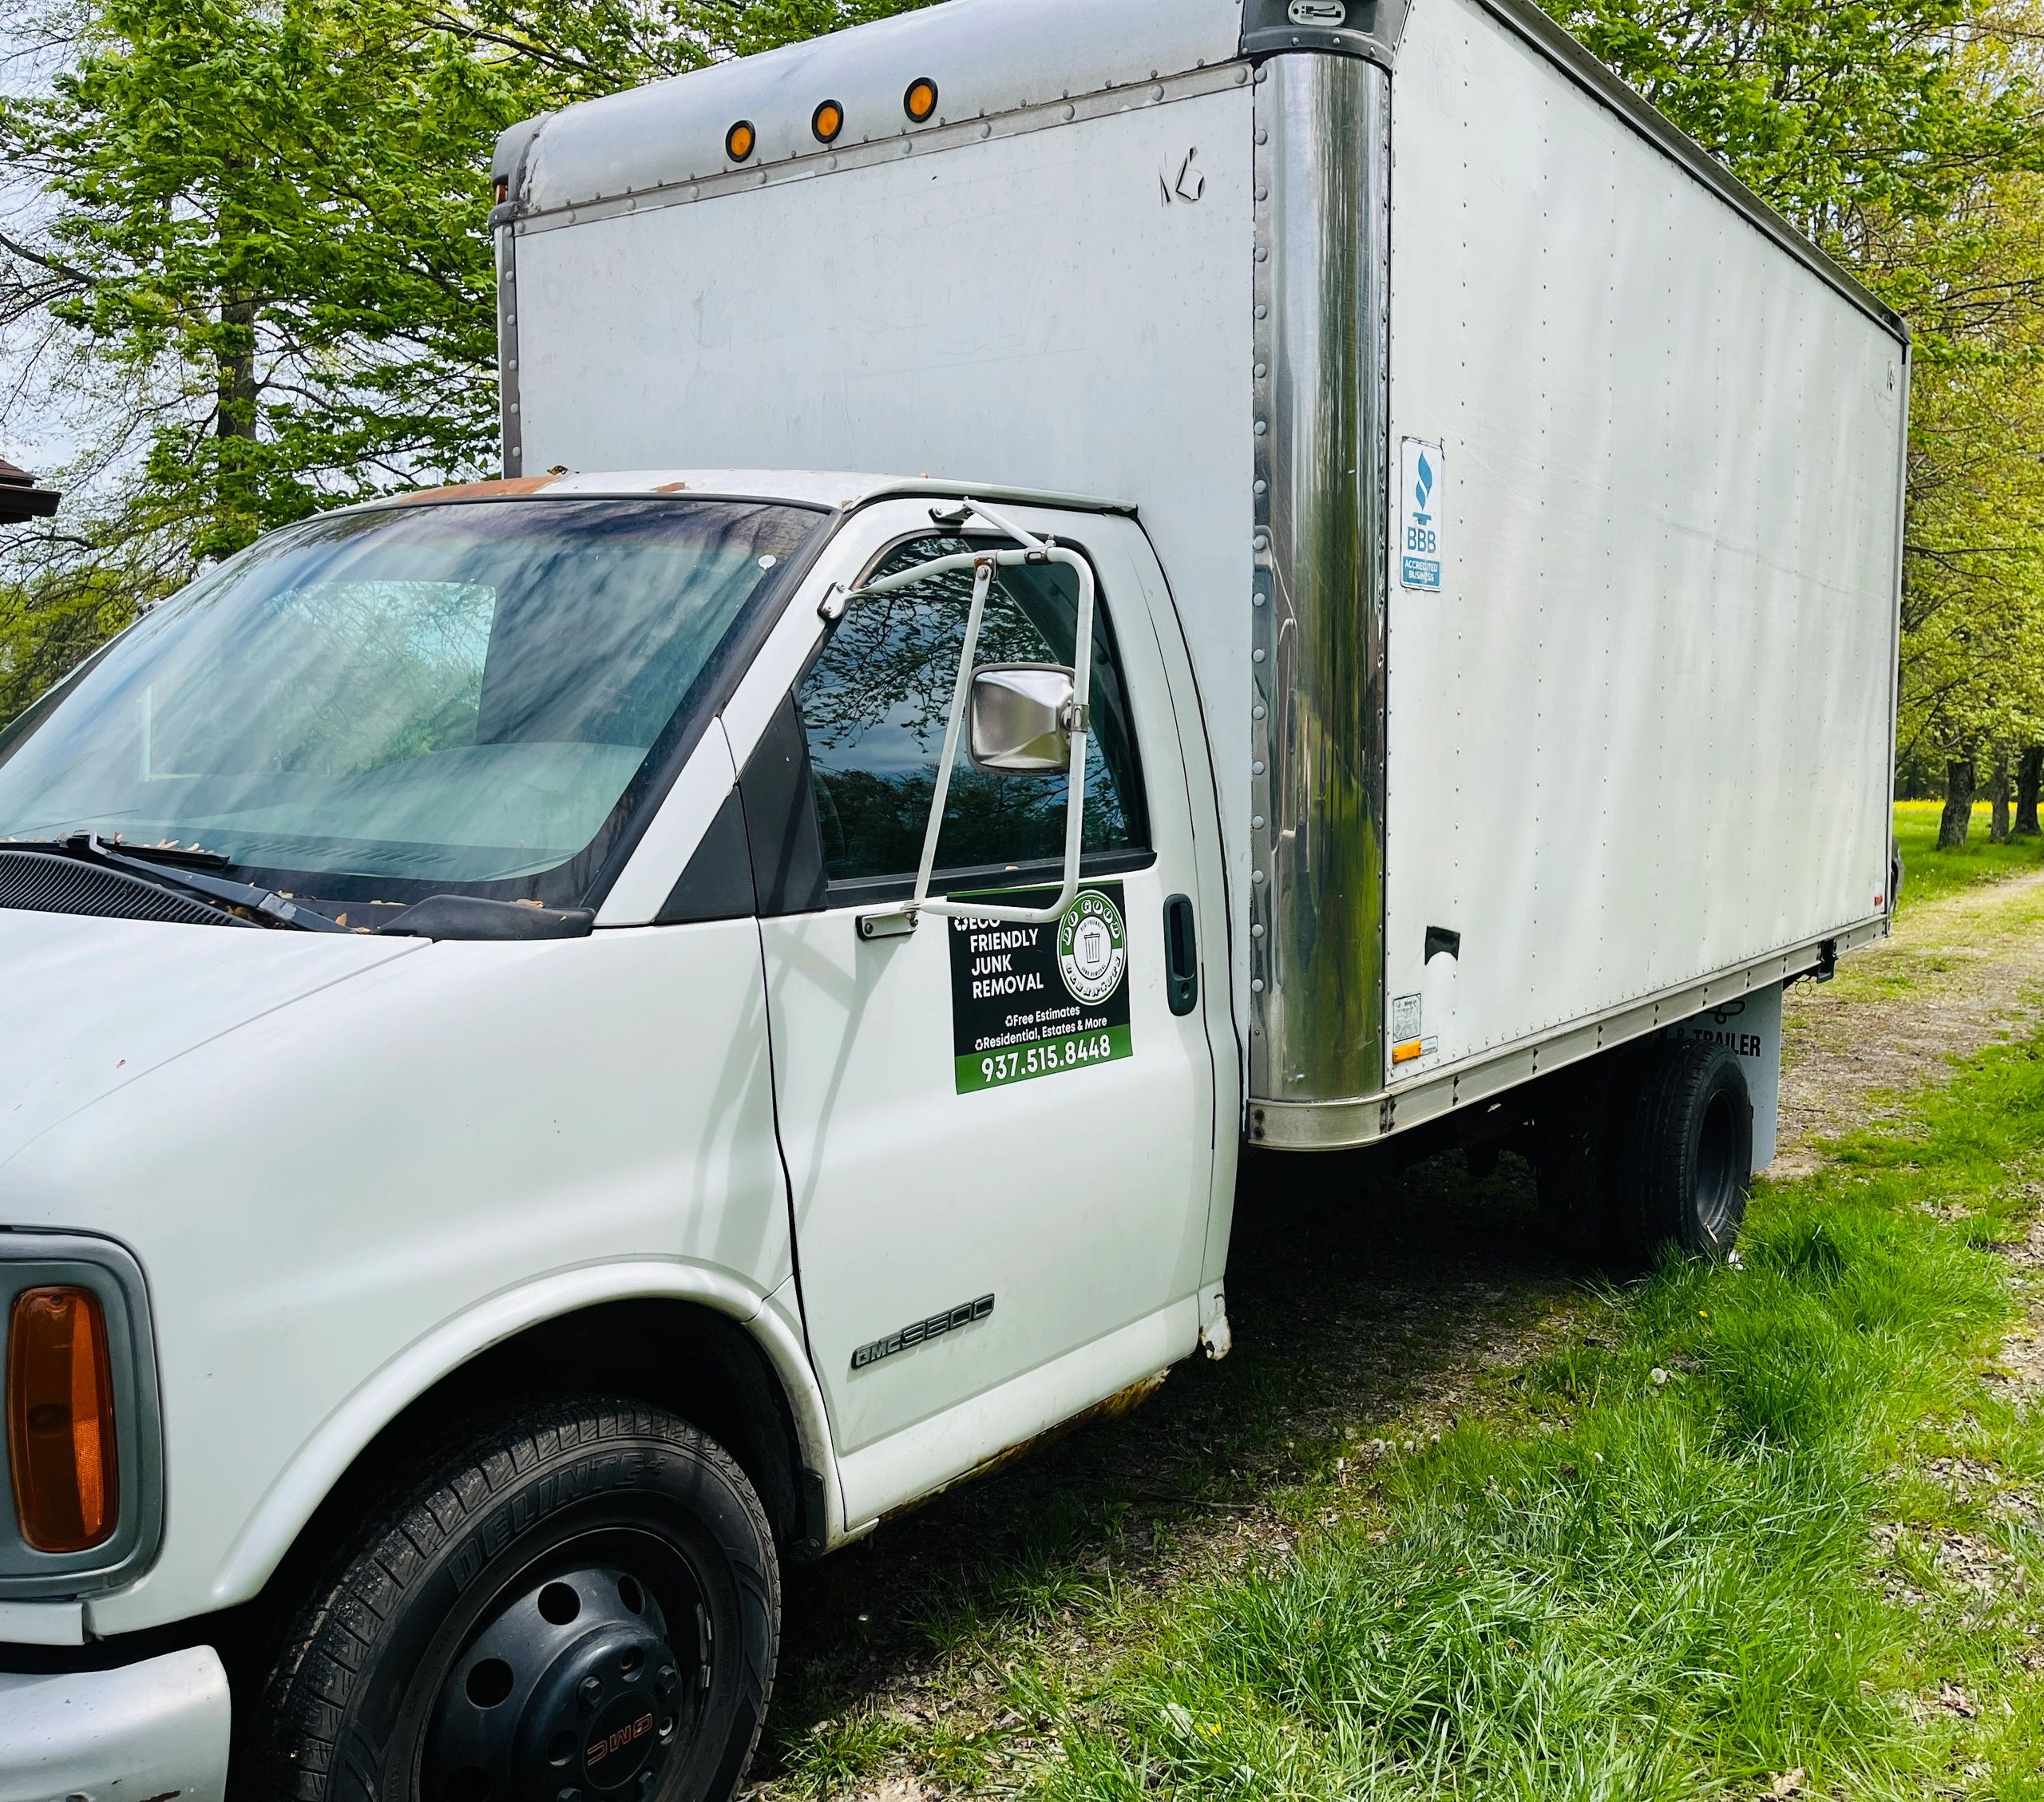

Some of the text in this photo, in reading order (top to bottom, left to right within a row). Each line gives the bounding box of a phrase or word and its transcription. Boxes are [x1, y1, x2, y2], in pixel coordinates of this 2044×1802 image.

[1407, 526, 1436, 553] BBB
[1404, 559, 1438, 572] ACCREDITED
[1408, 569, 1435, 582] BUSINESS
[1063, 899, 1120, 947] DO GOOD
[969, 929, 1039, 953] FRIENDLY
[971, 954, 1012, 976] JUNK
[972, 972, 1044, 999] REMOVAL
[1013, 1006, 1080, 1027] Free Estimates
[983, 1016, 1107, 1049] Residential, Estates & More
[981, 1034, 1111, 1083] 937.515.8448
[901, 1293, 995, 1349] 3500
[588, 1713, 653, 1766] GMC
